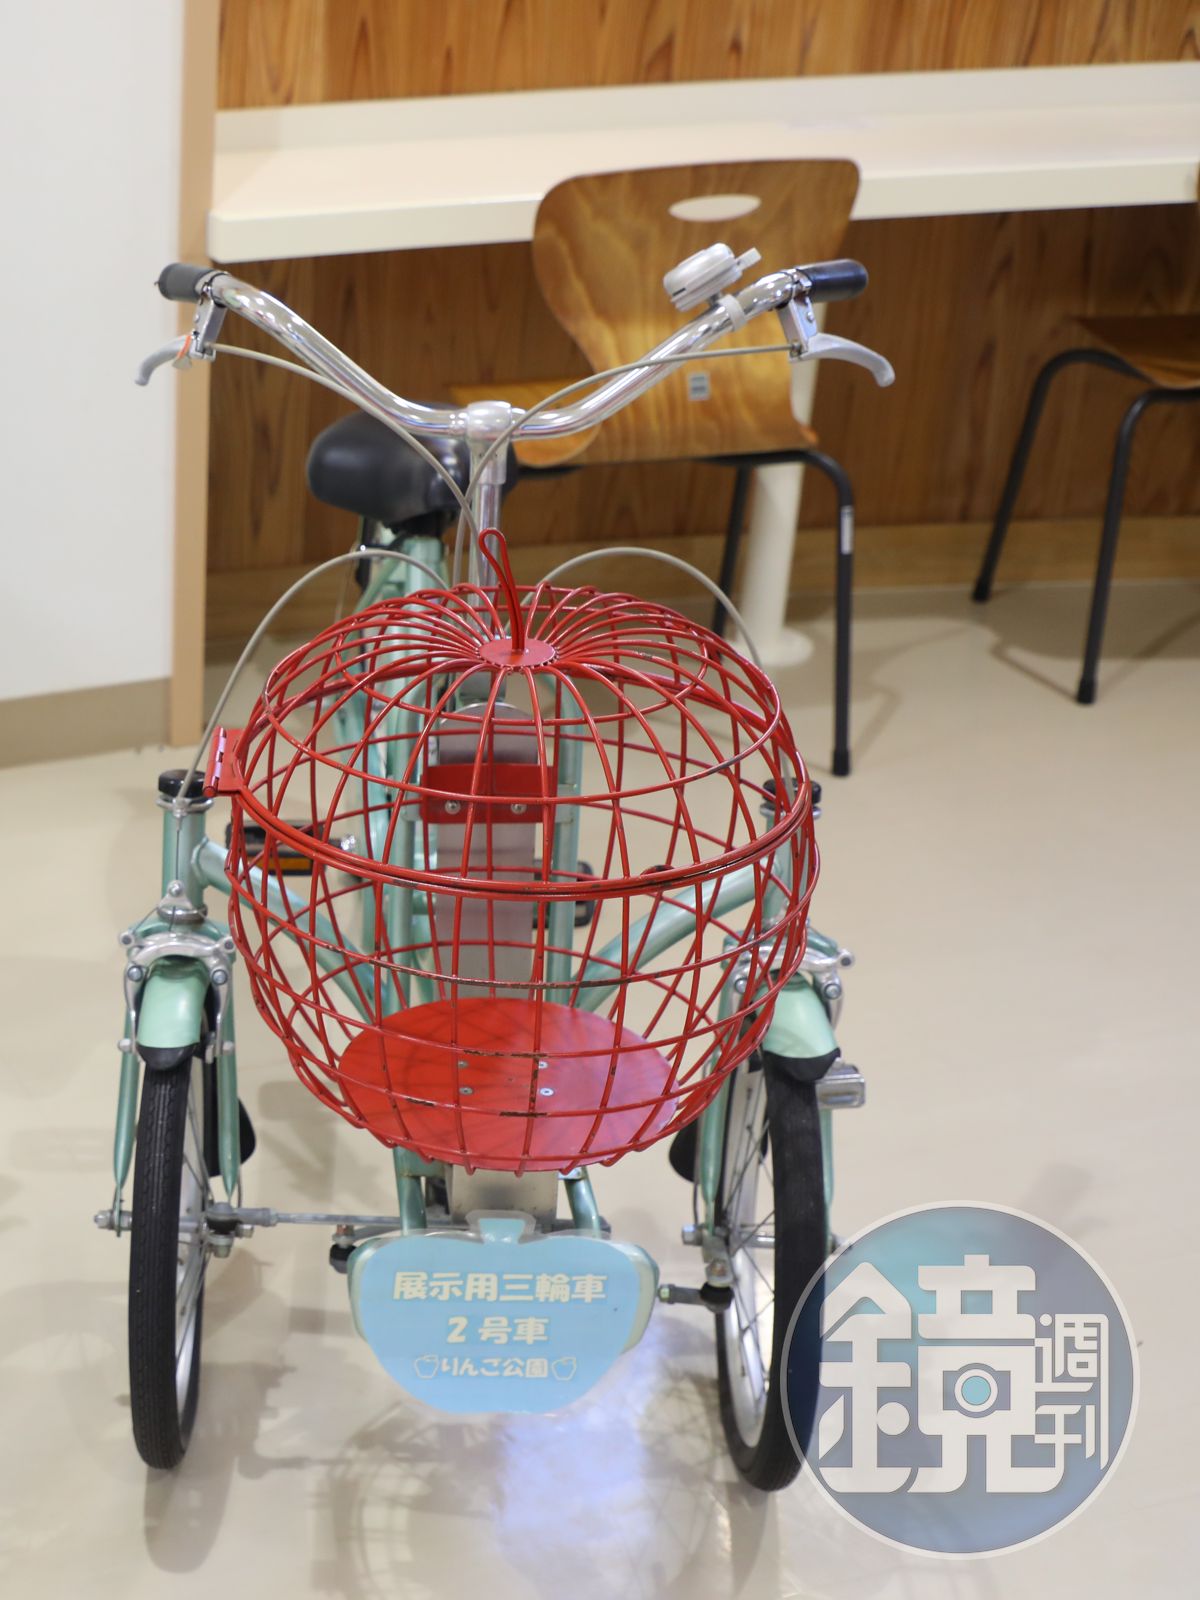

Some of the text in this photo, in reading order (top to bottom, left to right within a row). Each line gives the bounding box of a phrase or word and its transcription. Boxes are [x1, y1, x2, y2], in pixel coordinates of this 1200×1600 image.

[393, 1271, 607, 1302] 展示用三輪車
